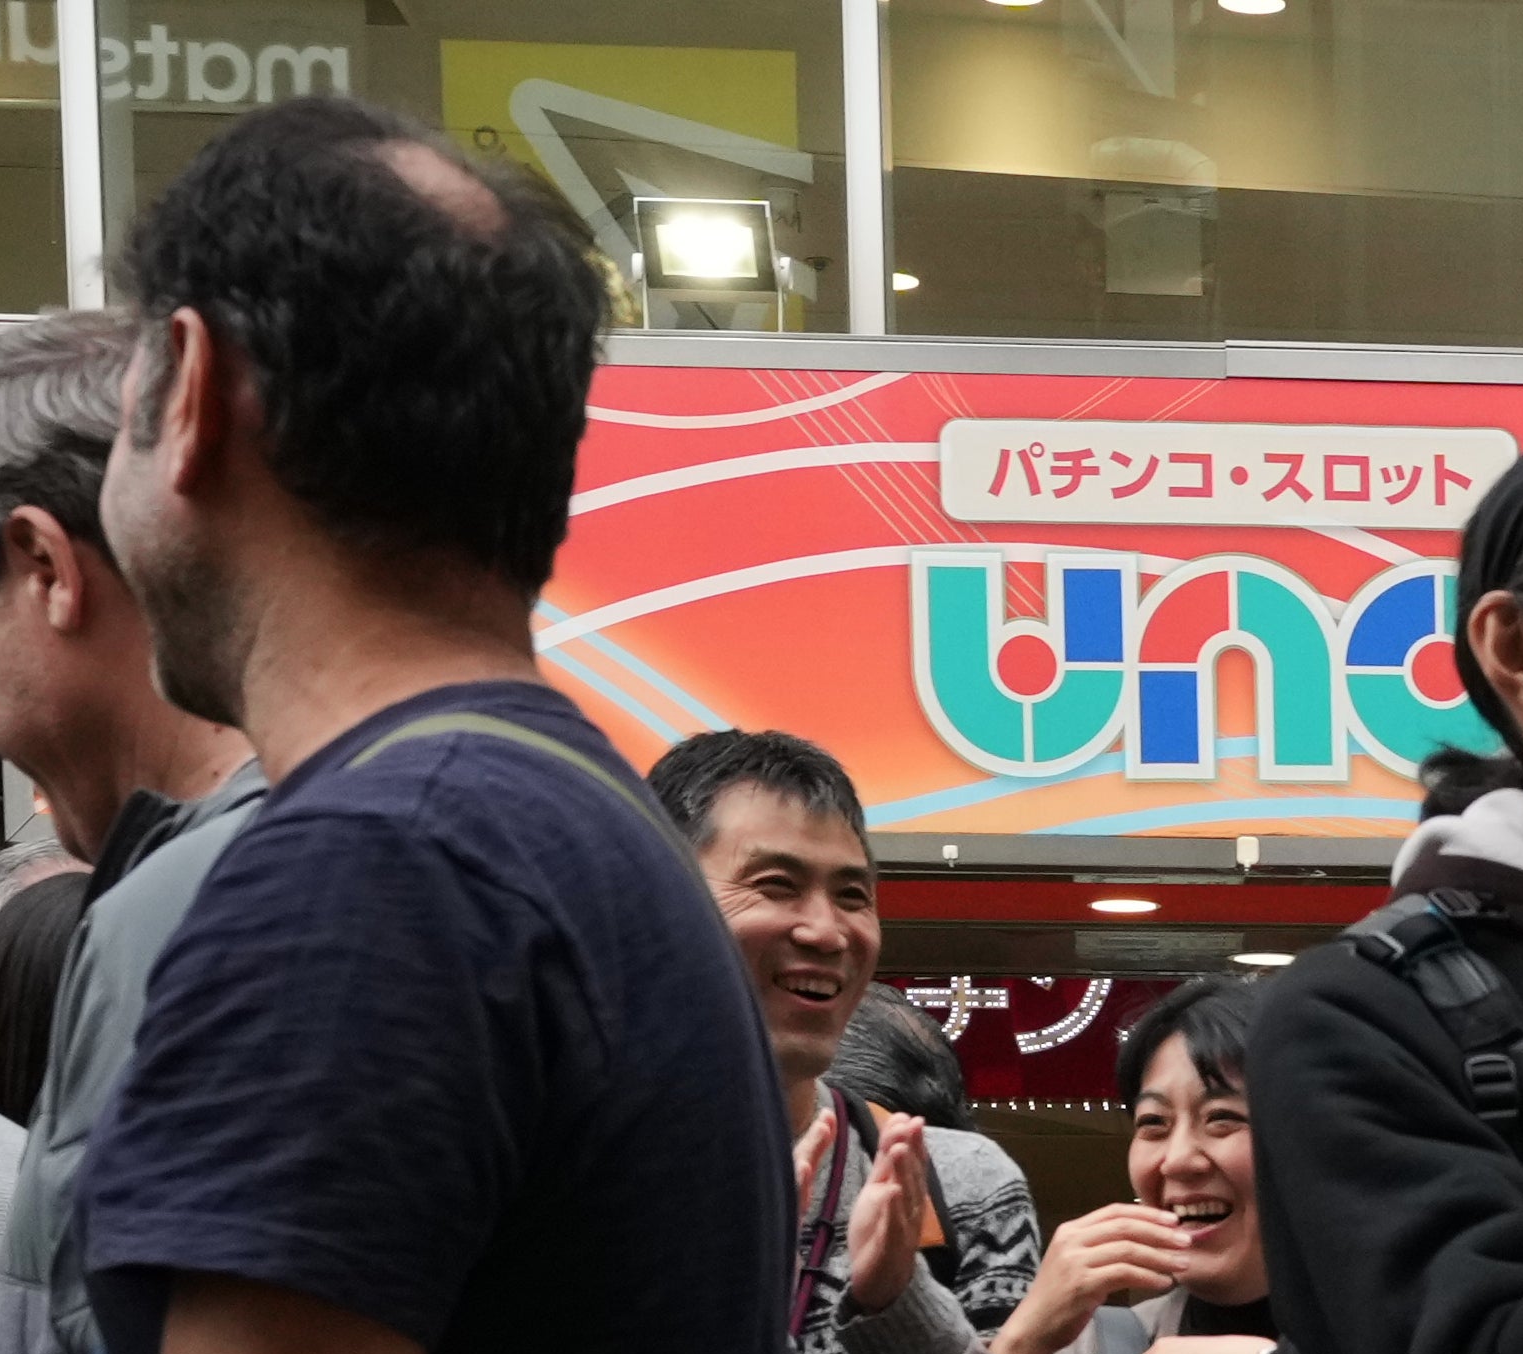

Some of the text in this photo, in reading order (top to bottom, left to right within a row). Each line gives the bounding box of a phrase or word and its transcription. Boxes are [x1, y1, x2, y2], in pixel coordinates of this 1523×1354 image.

[987, 441, 1473, 506] パチンコ・スロット
